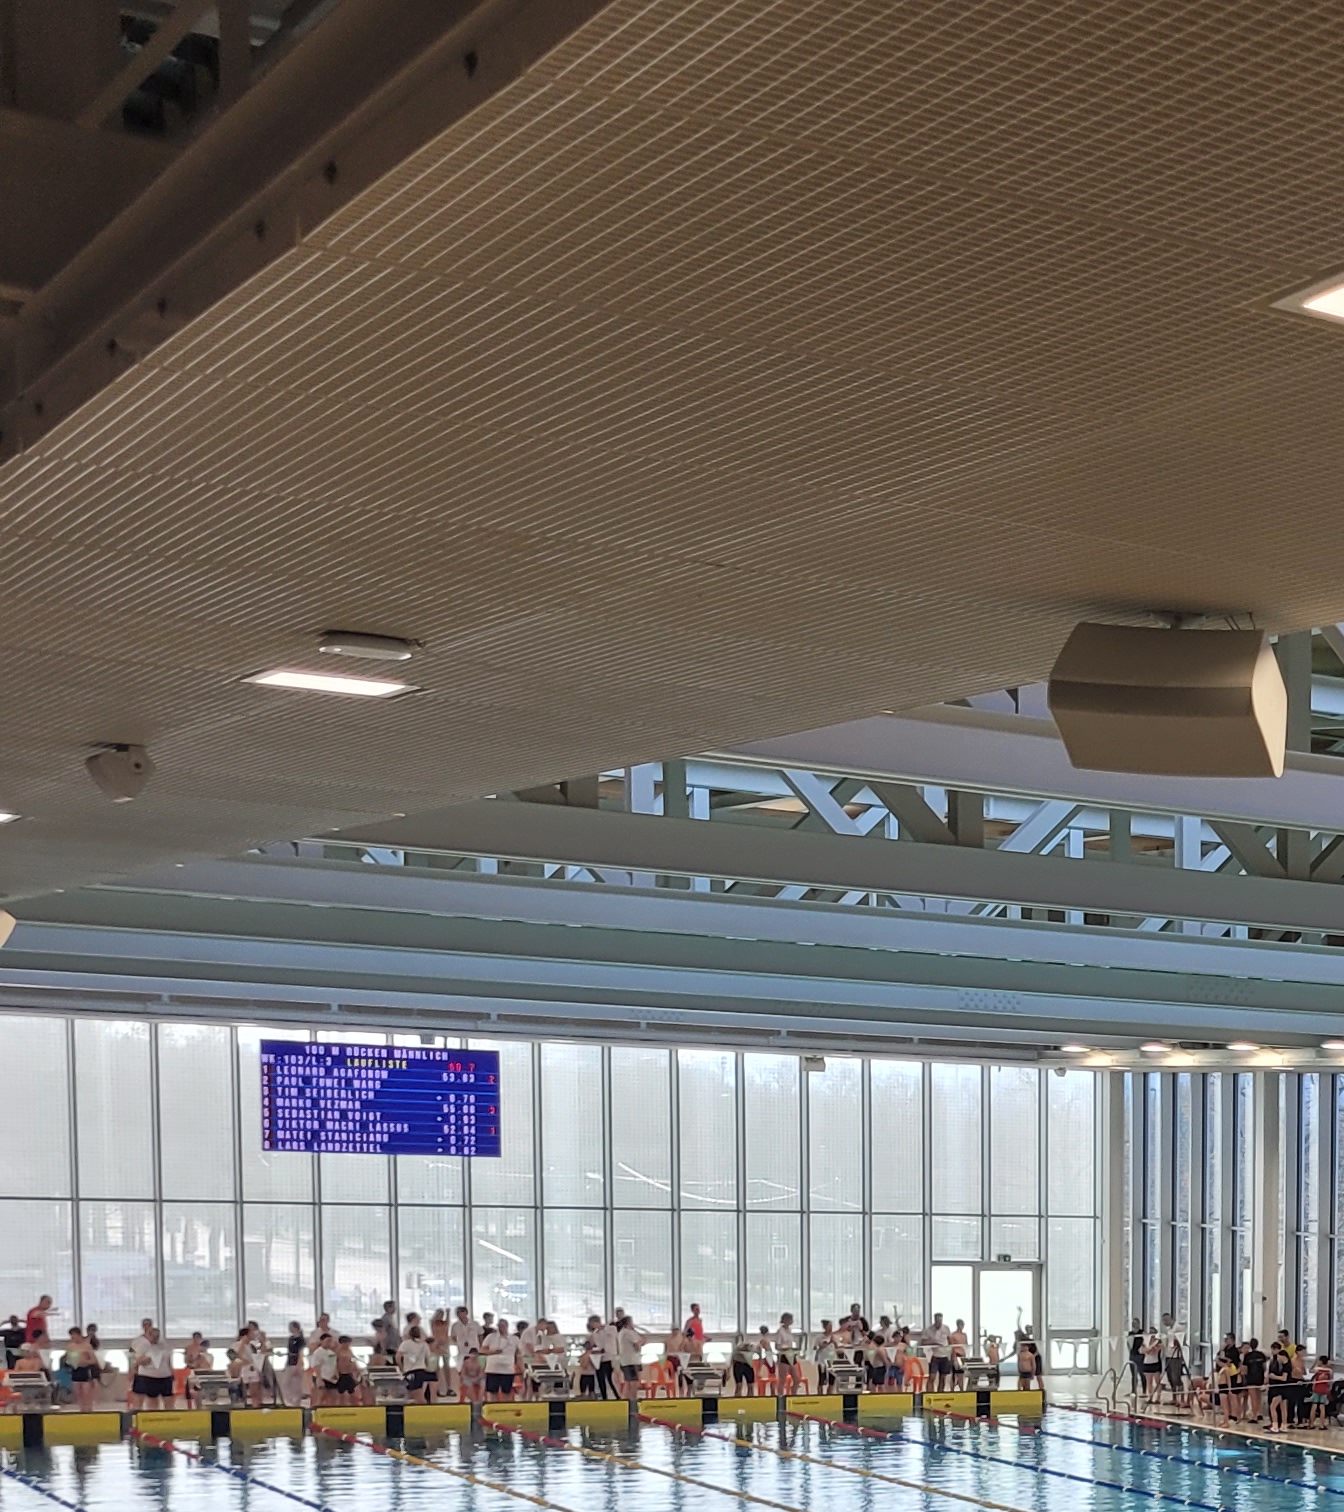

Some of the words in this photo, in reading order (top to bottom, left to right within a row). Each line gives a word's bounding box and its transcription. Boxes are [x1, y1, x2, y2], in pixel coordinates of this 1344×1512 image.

[347, 1058, 407, 1069] LAUFLISTE
[276, 1066, 325, 1076] LEONARD
[263, 1076, 269, 1085] 2
[276, 1077, 304, 1086] PAUL
[353, 1080, 381, 1089] WANG
[277, 1087, 298, 1096] TIM
[305, 1088, 374, 1099] SEIBERLICH
[263, 1098, 269, 1106] 4
[276, 1098, 312, 1107] MARKO
[320, 1100, 361, 1109] VEZMAR
[263, 1108, 269, 1117] 5
[277, 1109, 340, 1119] SEBASTIAN
[347, 1111, 381, 1120] VOIGT
[277, 1120, 319, 1129] VIKTOR
[369, 1122, 409, 1132] LASSUS
[264, 1130, 270, 1138] 7
[277, 1131, 311, 1140] MATEI
[320, 1132, 389, 1142] STANICIANU
[278, 1141, 306, 1150] LARS
[314, 1142, 381, 1152] LANDZETTEL
